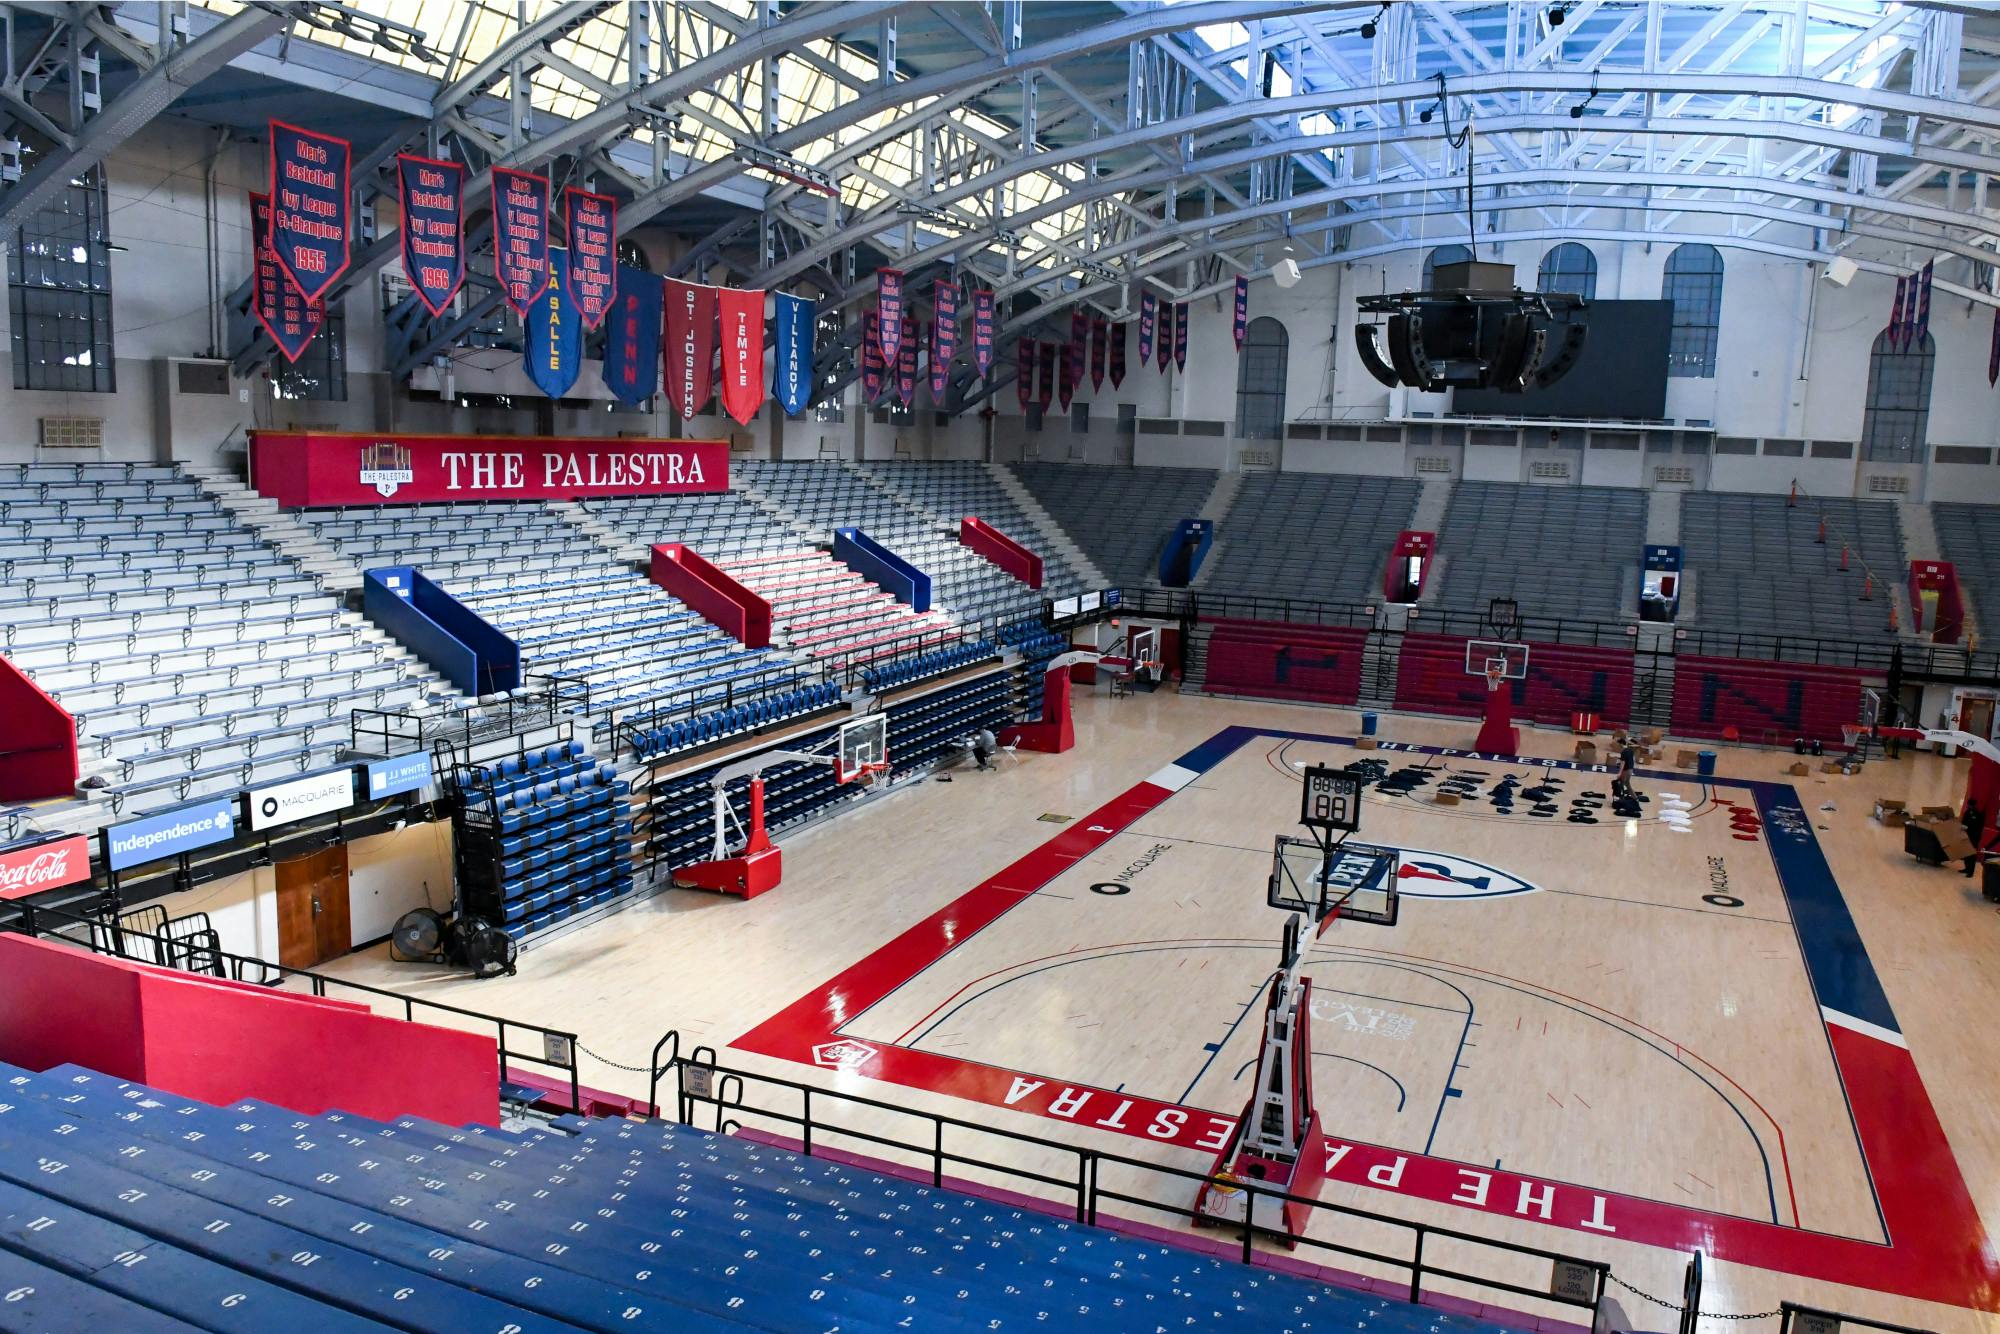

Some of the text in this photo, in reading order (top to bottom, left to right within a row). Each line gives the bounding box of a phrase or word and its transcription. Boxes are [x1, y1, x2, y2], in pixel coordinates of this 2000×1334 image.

[297, 139, 326, 164] Men's
[286, 161, 336, 189] Basketball
[420, 169, 444, 188] Men's
[282, 189, 336, 217] Ivy League
[412, 190, 454, 210] Basketball
[277, 210, 342, 240] Co-Champions
[428, 218, 456, 236] League
[412, 237, 456, 257] Champions
[294, 246, 326, 272] 1955
[421, 267, 449, 289] 1966
[548, 262, 560, 370] LA SALLE
[623, 294, 639, 385] PENN
[737, 312, 748, 386] TEMPLE
[788, 301, 800, 405] VILLANOVA
[684, 330, 695, 418] JOSEPHS
[363, 472, 410, 481] THE PALESTRA
[441, 452, 706, 490] THE PALESTRA
[1380, 741, 1423, 752] HE
[400, 762, 427, 777] WHITE
[282, 784, 345, 808] MACQUARIE
[112, 817, 213, 855] Independence
[1113, 843, 1173, 882] MACQUARIE
[1002, 1076, 1618, 1234] THE PAESTRA
[39, 1158, 70, 1175] 13
[190, 1169, 217, 1182] 13
[118, 1189, 148, 1203] 12
[267, 1194, 294, 1207] 12
[26, 1216, 57, 1232] 11
[203, 1219, 232, 1233] 11
[113, 1250, 148, 1268] 10
[291, 1251, 321, 1267] 10
[428, 1248, 455, 1261] 10
